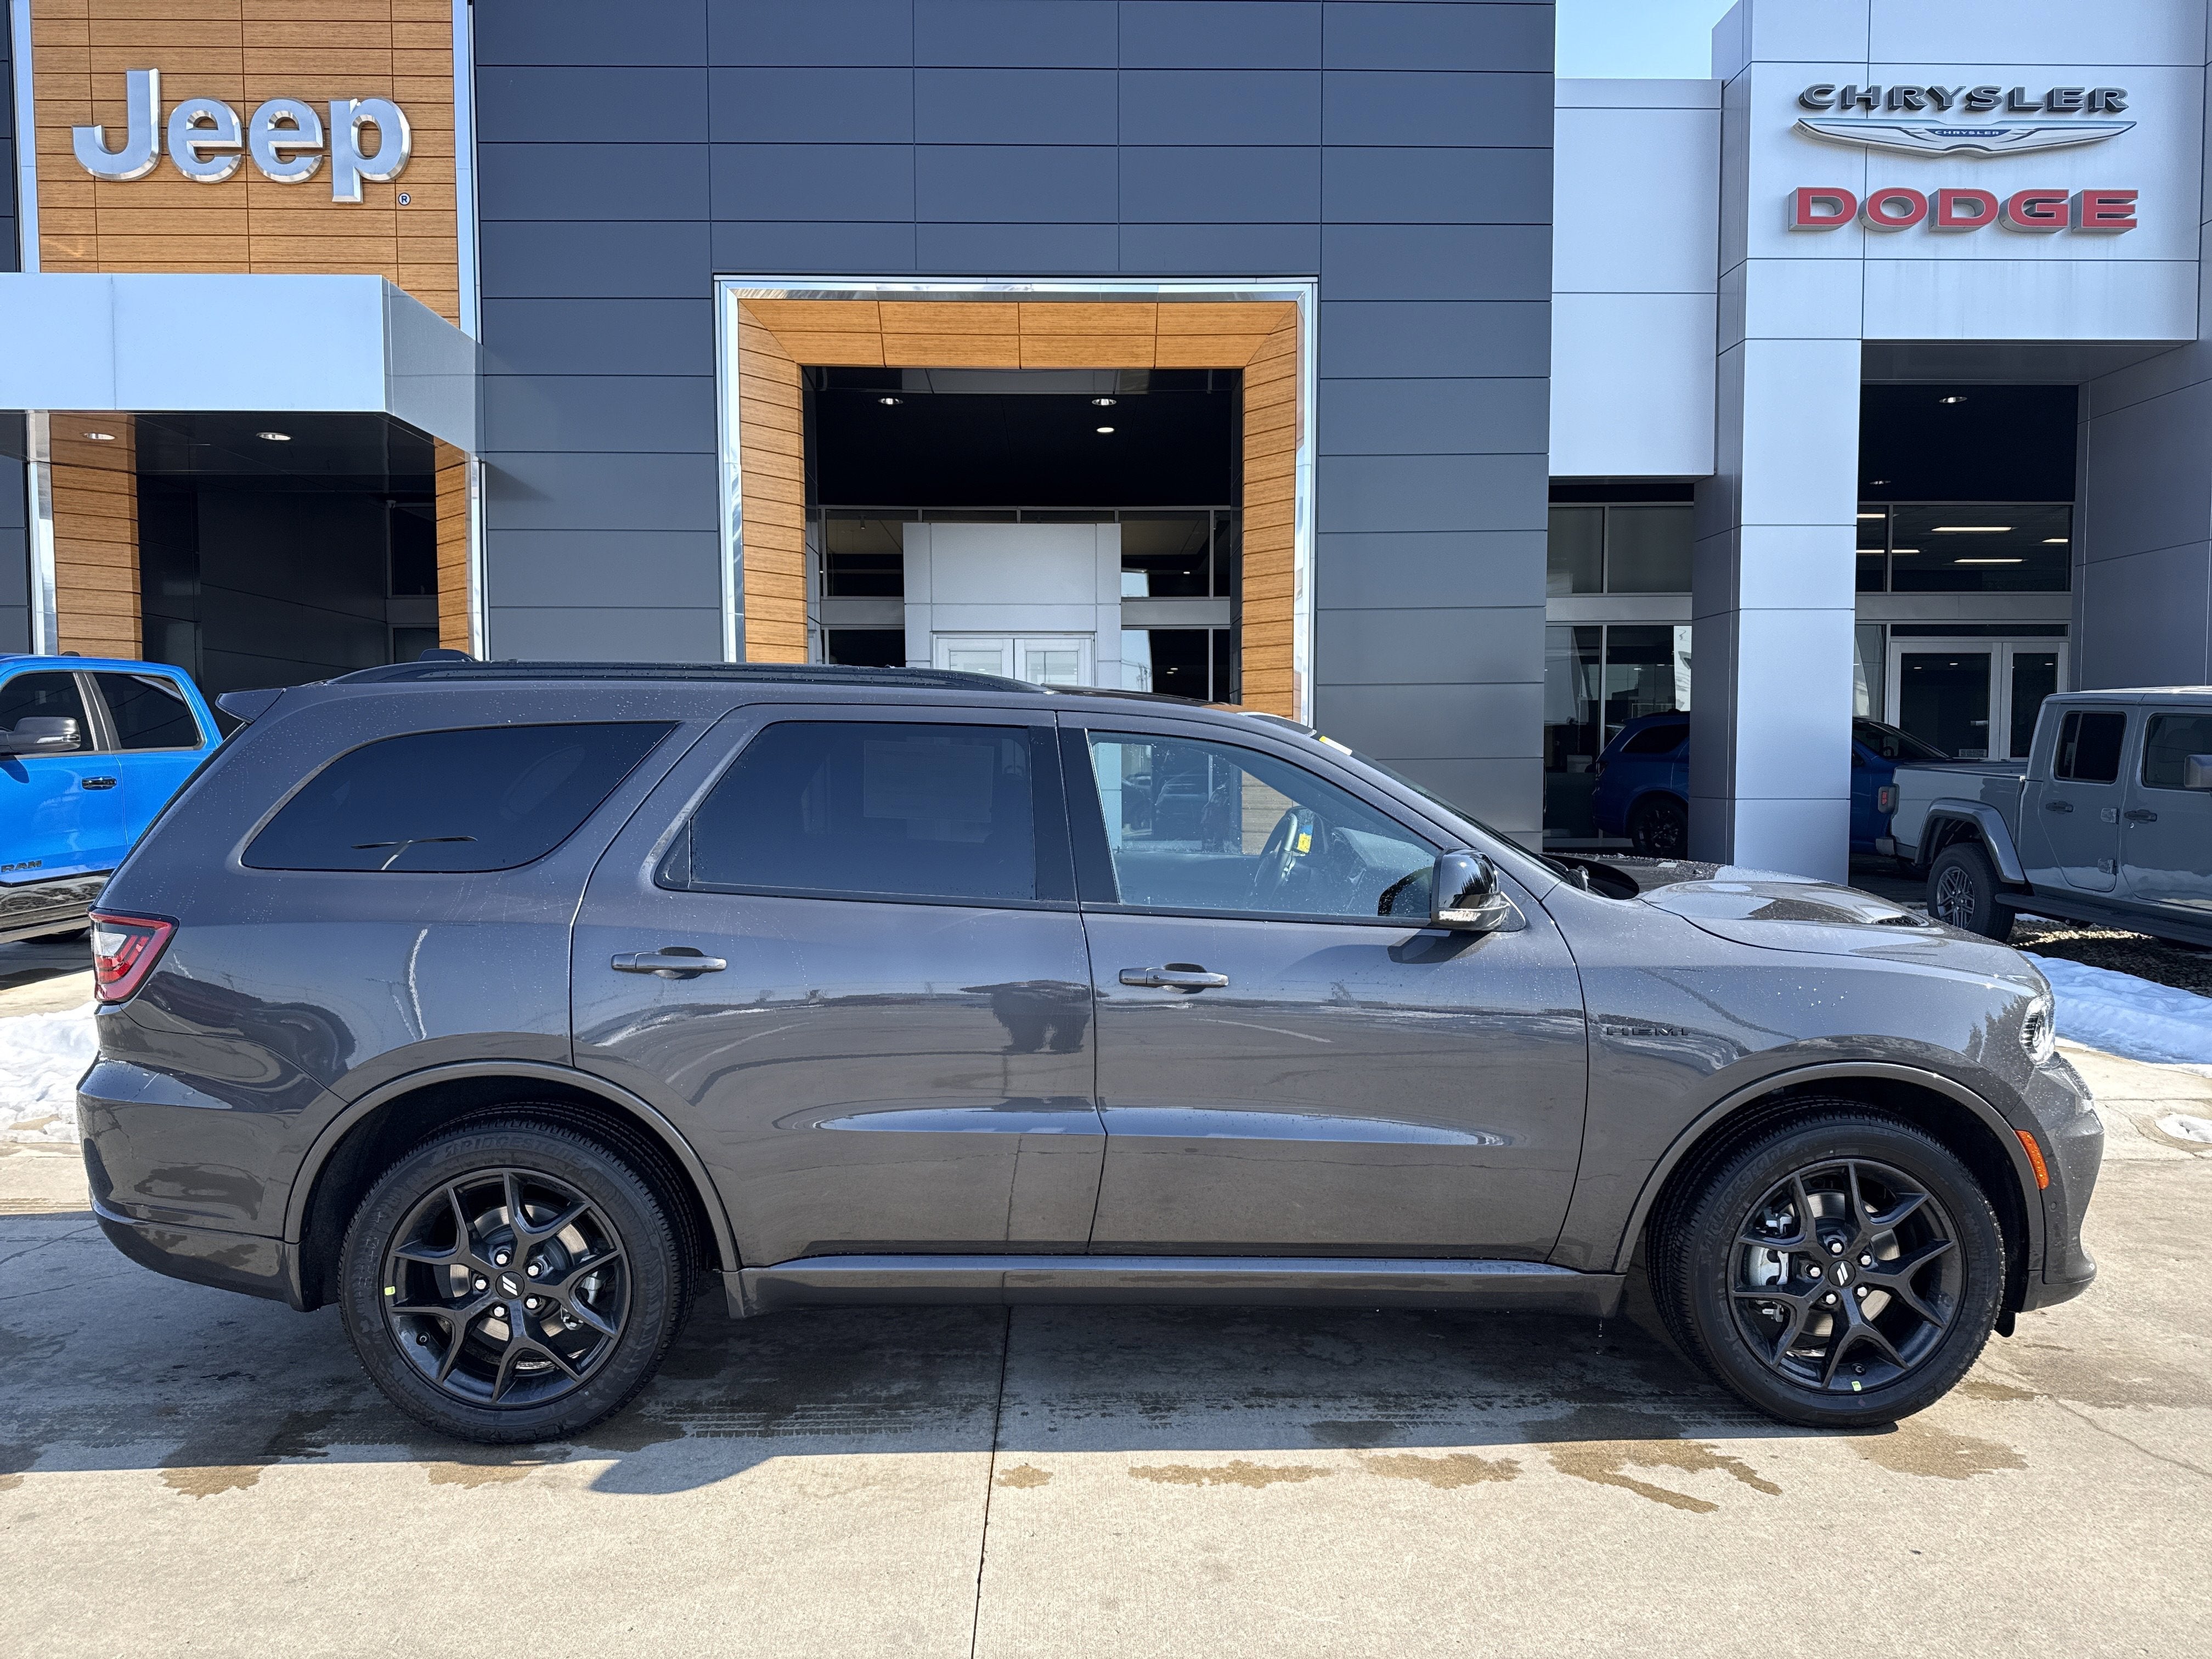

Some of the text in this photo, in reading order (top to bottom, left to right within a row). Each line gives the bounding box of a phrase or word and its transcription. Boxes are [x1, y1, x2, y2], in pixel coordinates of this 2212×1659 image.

[1799, 83, 2129, 112] CHRYSLER
[72, 68, 411, 204] Jeep
[1788, 187, 2138, 232] DODGE
[1, 860, 42, 873] RAM
[1606, 1028, 1689, 1036] HEMI
